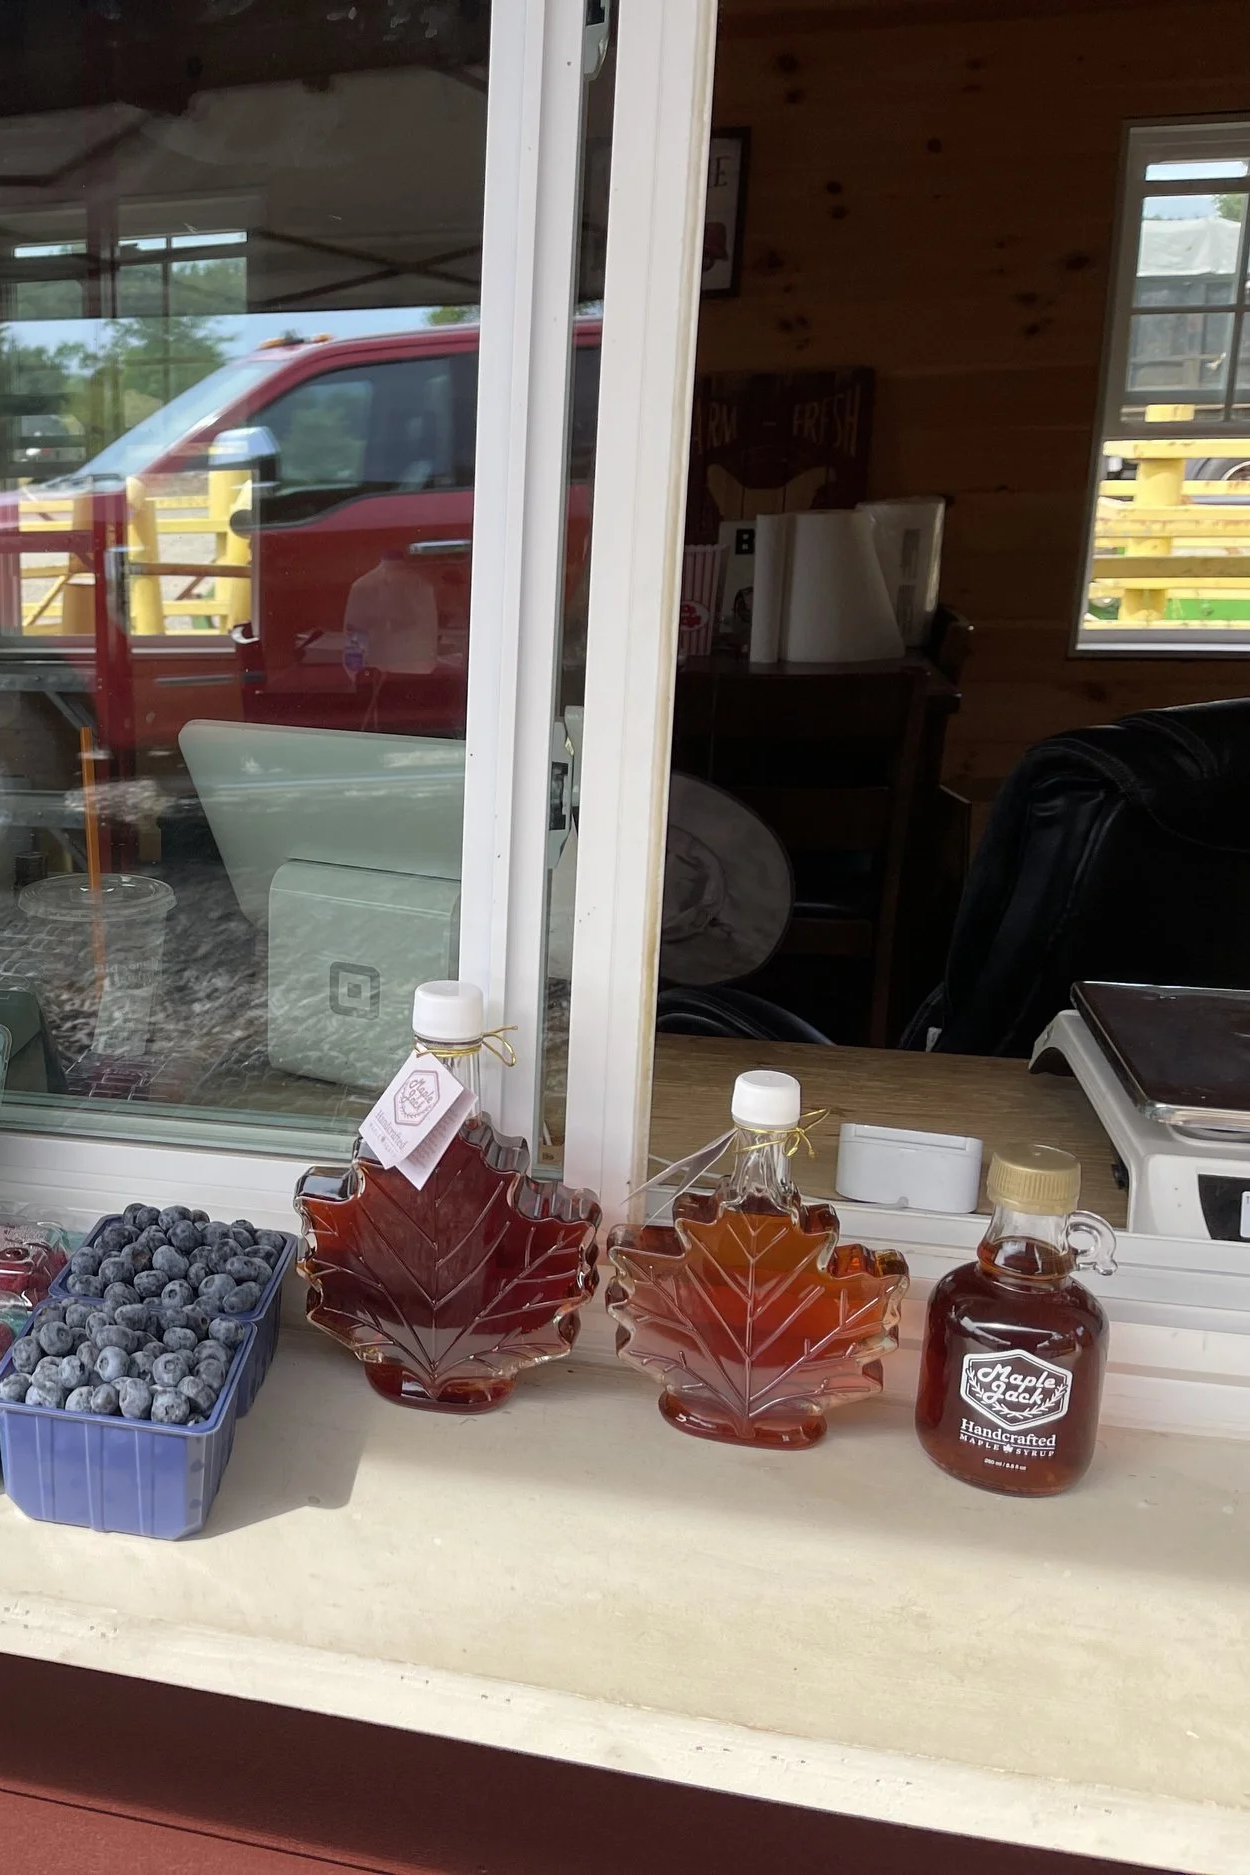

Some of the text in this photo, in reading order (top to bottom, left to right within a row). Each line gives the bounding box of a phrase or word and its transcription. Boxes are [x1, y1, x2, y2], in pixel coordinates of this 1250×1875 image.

[977, 1363, 1056, 1393] Maple
[982, 1380, 1044, 1405] Jack
[959, 1433, 1055, 1457] MAPLE SYRUP
[960, 1418, 1057, 1446] Handcrafted
